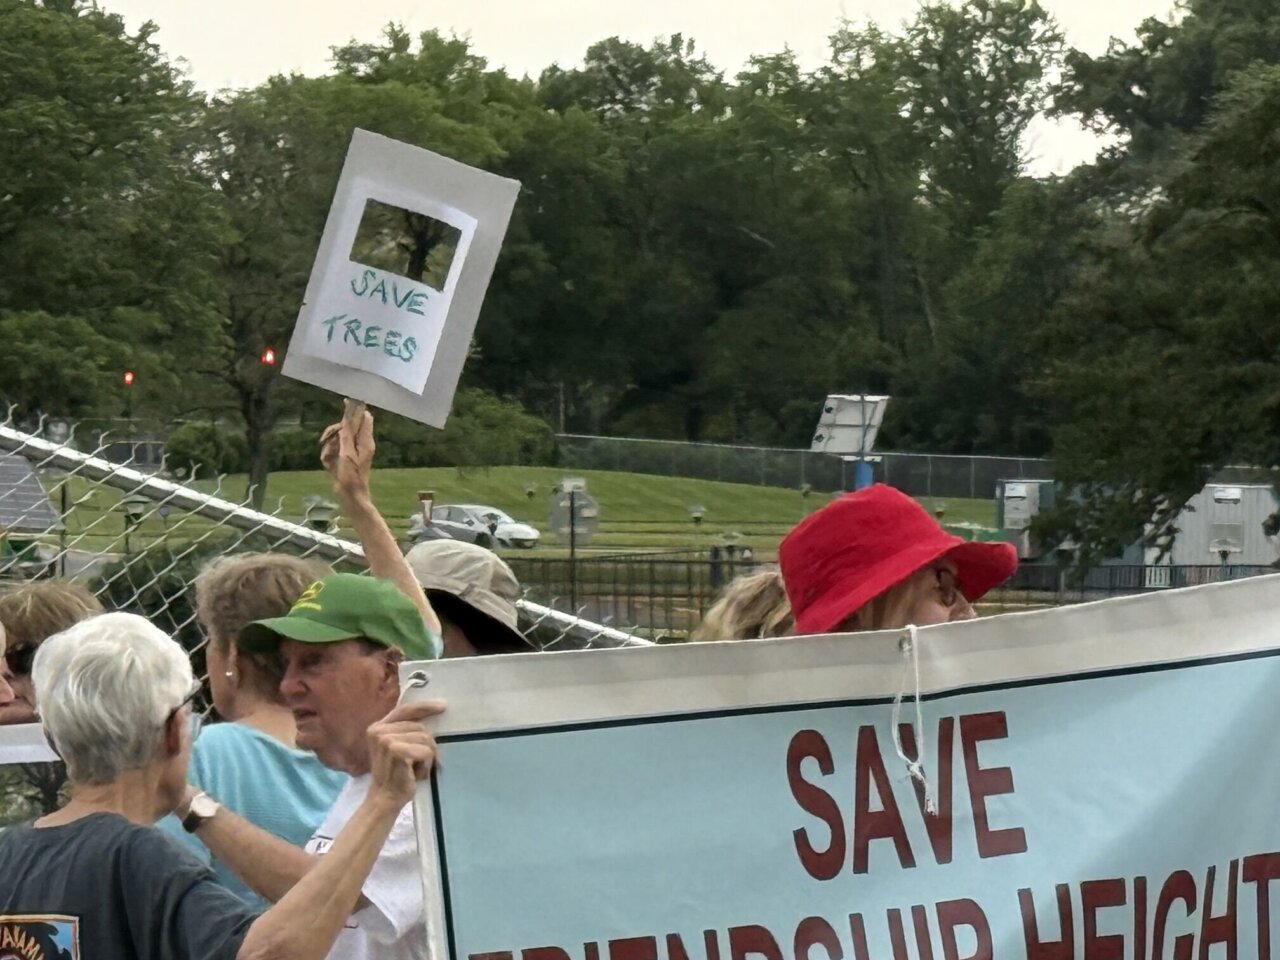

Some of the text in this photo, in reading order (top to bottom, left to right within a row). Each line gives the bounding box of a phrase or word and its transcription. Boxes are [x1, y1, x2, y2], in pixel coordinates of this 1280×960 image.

[350, 269, 429, 316] SAVE
[322, 314, 417, 362] TREES
[786, 711, 1027, 880] SAVE
